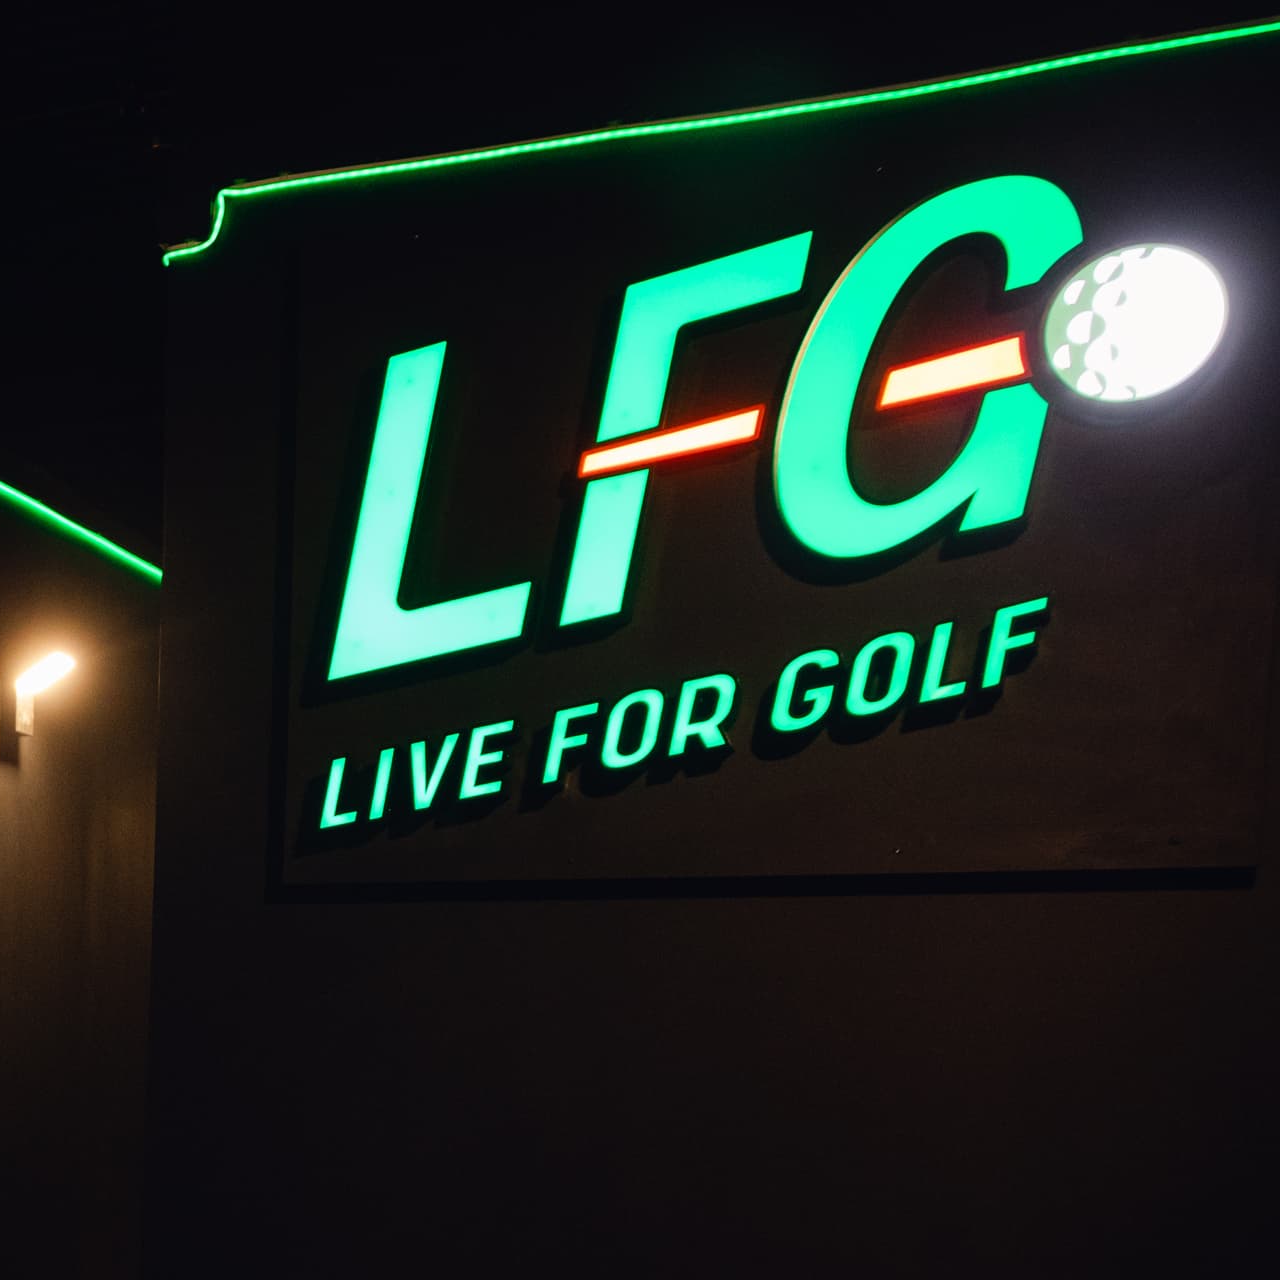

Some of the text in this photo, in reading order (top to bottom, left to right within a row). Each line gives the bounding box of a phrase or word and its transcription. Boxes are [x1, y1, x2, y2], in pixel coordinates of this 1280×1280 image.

[327, 174, 1083, 681] LFG
[319, 597, 1048, 829] LIVE FOR GOLF
